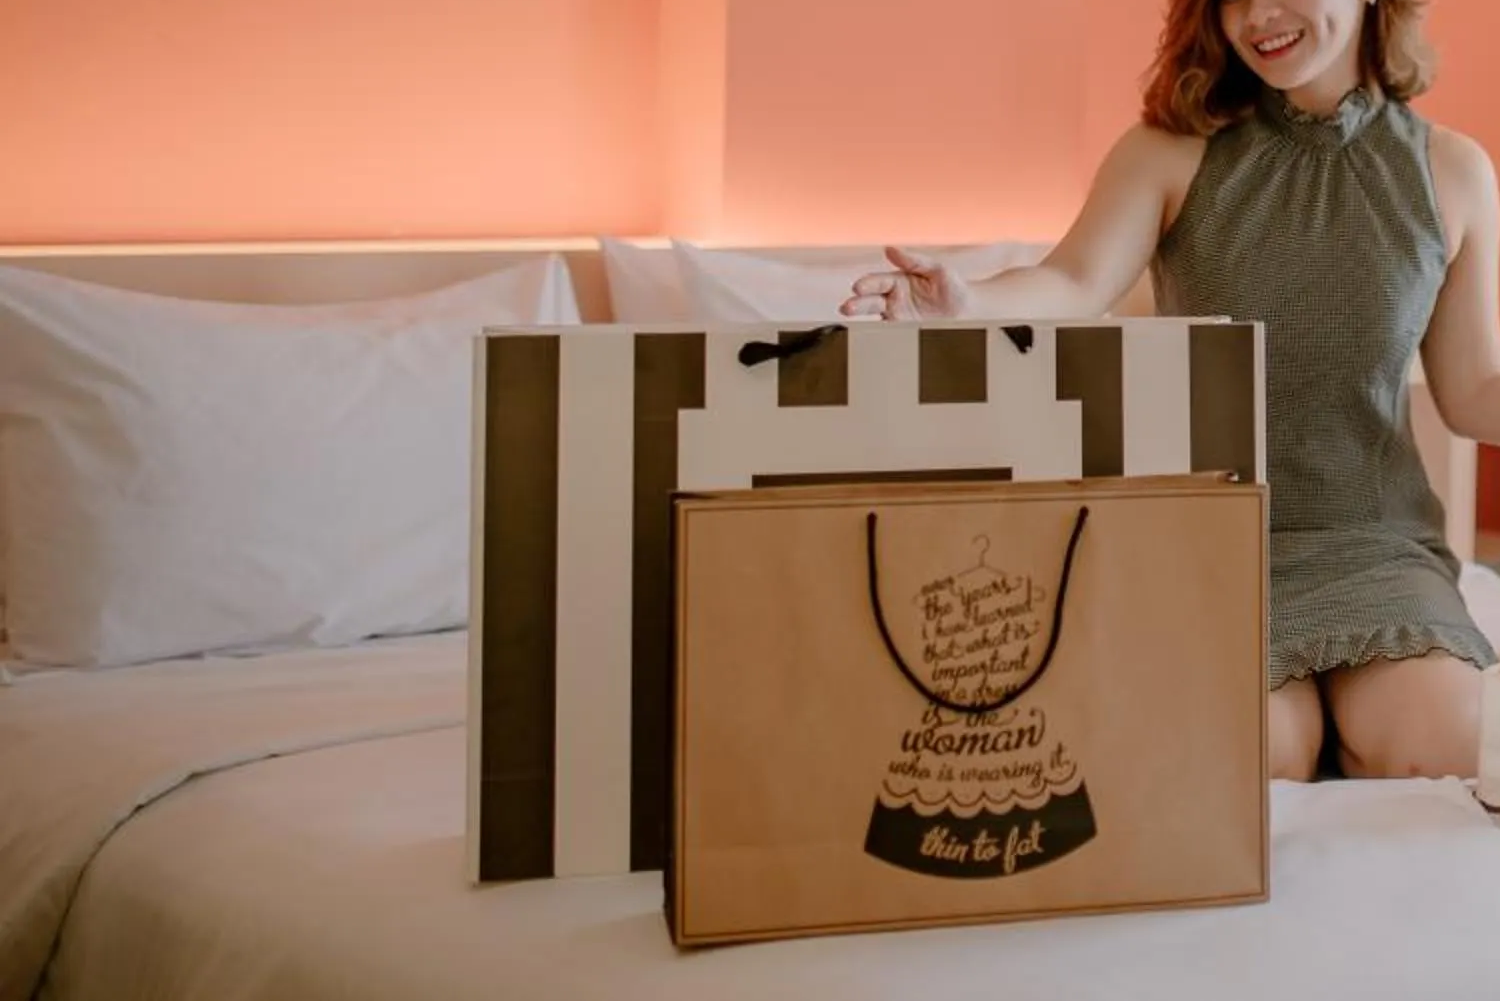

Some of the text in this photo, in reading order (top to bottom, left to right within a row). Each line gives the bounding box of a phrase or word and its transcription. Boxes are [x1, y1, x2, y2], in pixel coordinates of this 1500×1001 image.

[932, 645, 1030, 688] important
[901, 708, 1045, 756] woman
[888, 754, 931, 781] who
[936, 762, 955, 782] is
[960, 760, 1043, 788] wearing
[920, 820, 1047, 875] thin to fat
